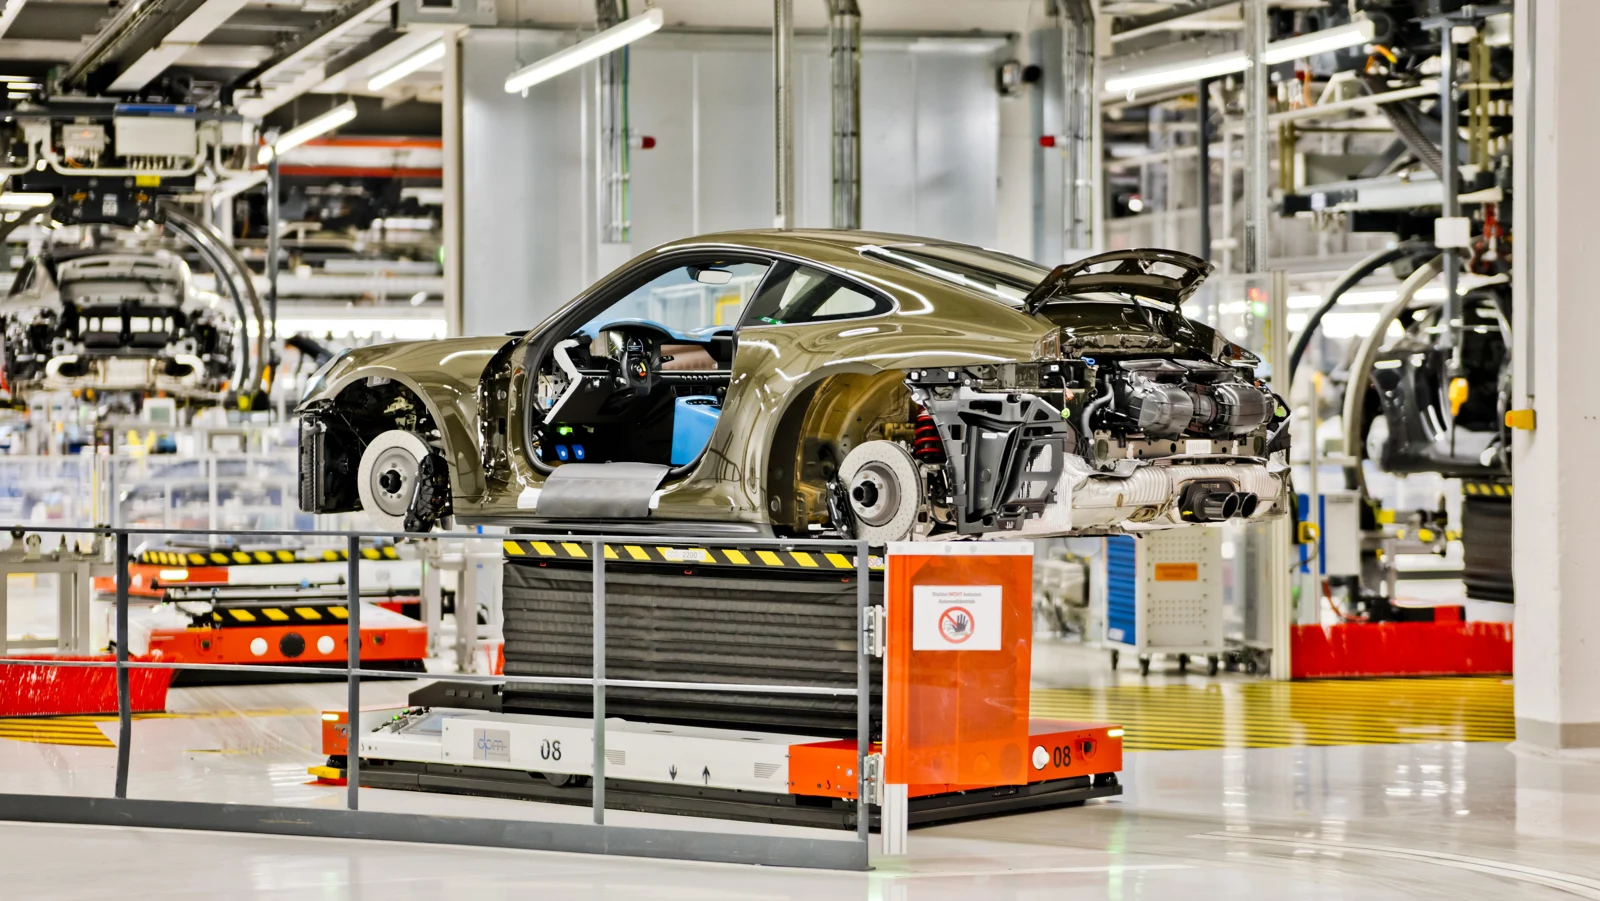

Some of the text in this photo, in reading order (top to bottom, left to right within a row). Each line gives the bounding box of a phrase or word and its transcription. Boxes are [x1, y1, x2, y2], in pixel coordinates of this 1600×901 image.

[682, 551, 698, 559] 2200
[541, 738, 562, 761] 08
[1053, 745, 1071, 768] 08
